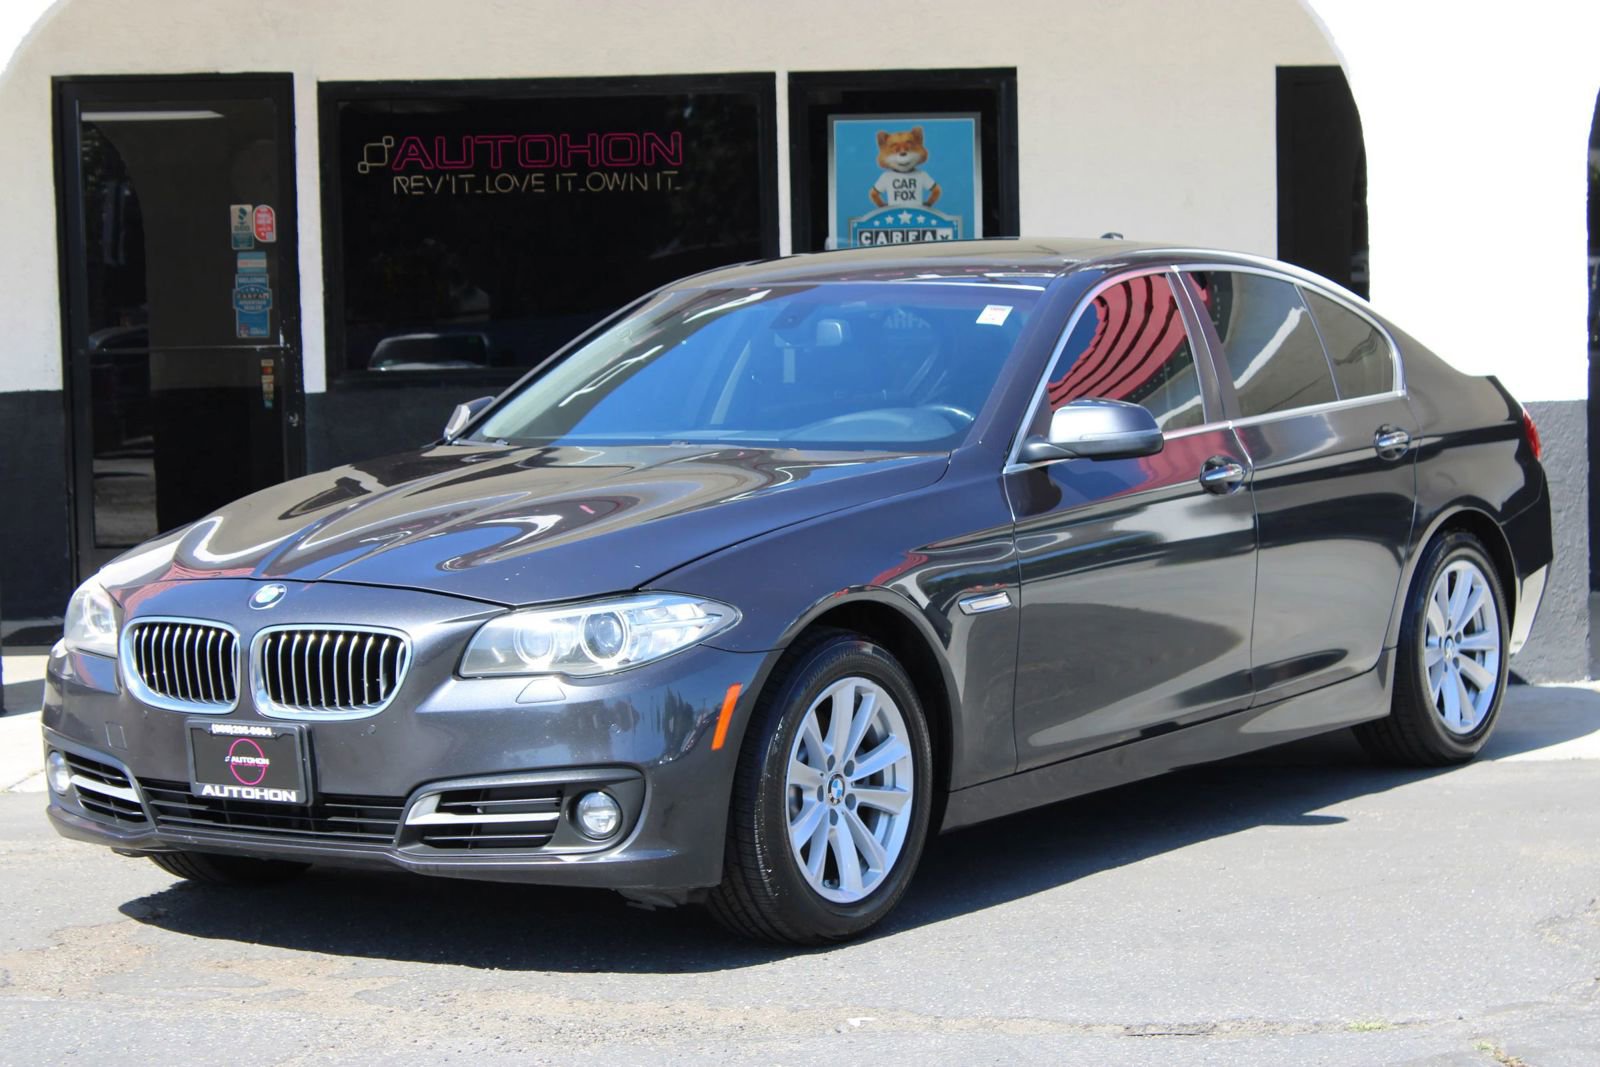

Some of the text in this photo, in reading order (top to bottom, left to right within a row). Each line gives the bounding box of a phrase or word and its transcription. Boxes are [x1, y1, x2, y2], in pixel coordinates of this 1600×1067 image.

[392, 131, 683, 170] AUTOHON
[892, 178, 917, 189] CAR
[894, 190, 916, 201] FOX
[231, 756, 270, 765] AUTOHON
[202, 785, 296, 802] AUTOHON
